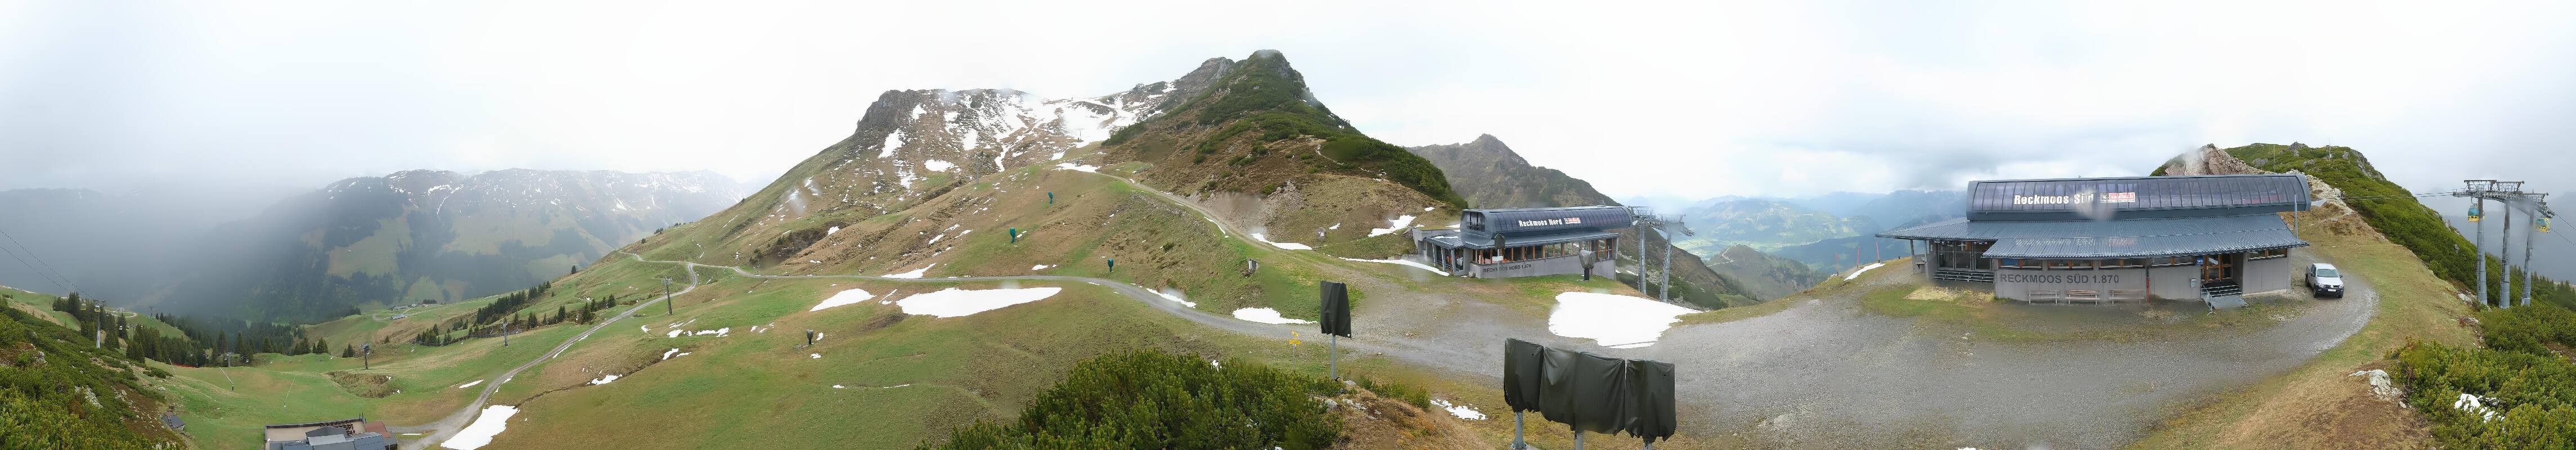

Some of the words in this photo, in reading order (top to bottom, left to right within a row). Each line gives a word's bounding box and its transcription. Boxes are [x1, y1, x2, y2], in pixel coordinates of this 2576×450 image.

[2014, 194, 2069, 205] Reckmoos
[2074, 194, 2093, 204] Süd
[2000, 274, 2061, 284] RECKMOOS
[2067, 273, 2088, 284] SÜD
[2092, 274, 2119, 284] 1.870
